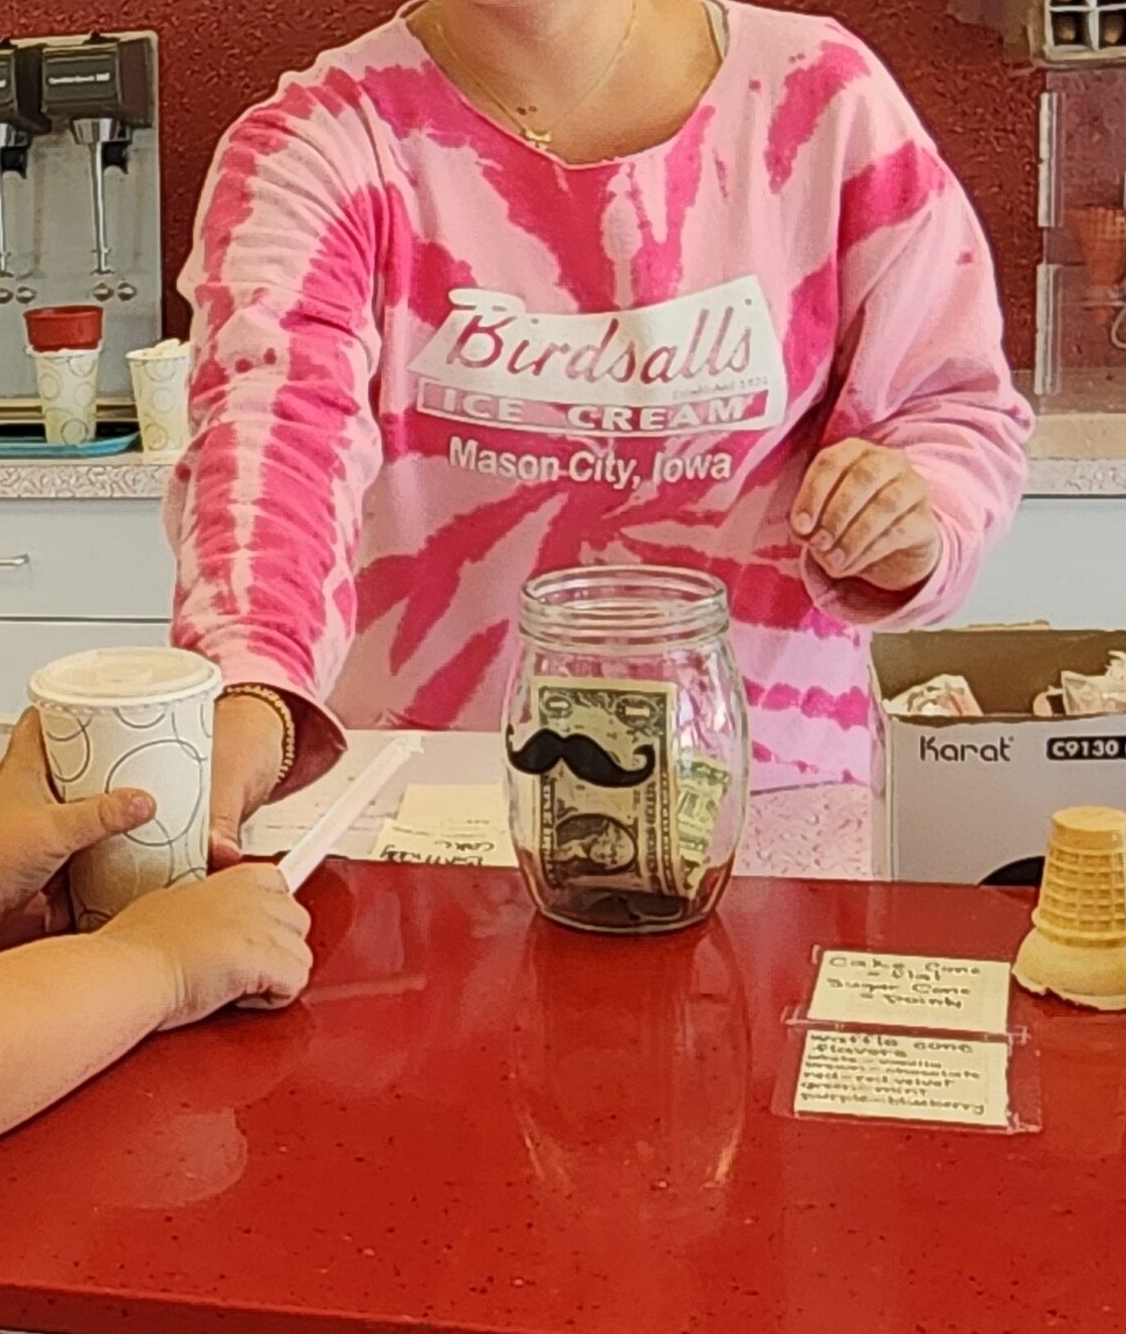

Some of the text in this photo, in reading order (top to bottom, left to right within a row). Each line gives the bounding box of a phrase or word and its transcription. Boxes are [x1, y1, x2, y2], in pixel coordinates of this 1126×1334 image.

[442, 388, 744, 431] ICE CREAM
[449, 436, 732, 490] Mason City, Iowa
[920, 735, 1119, 762] Karat C9130
